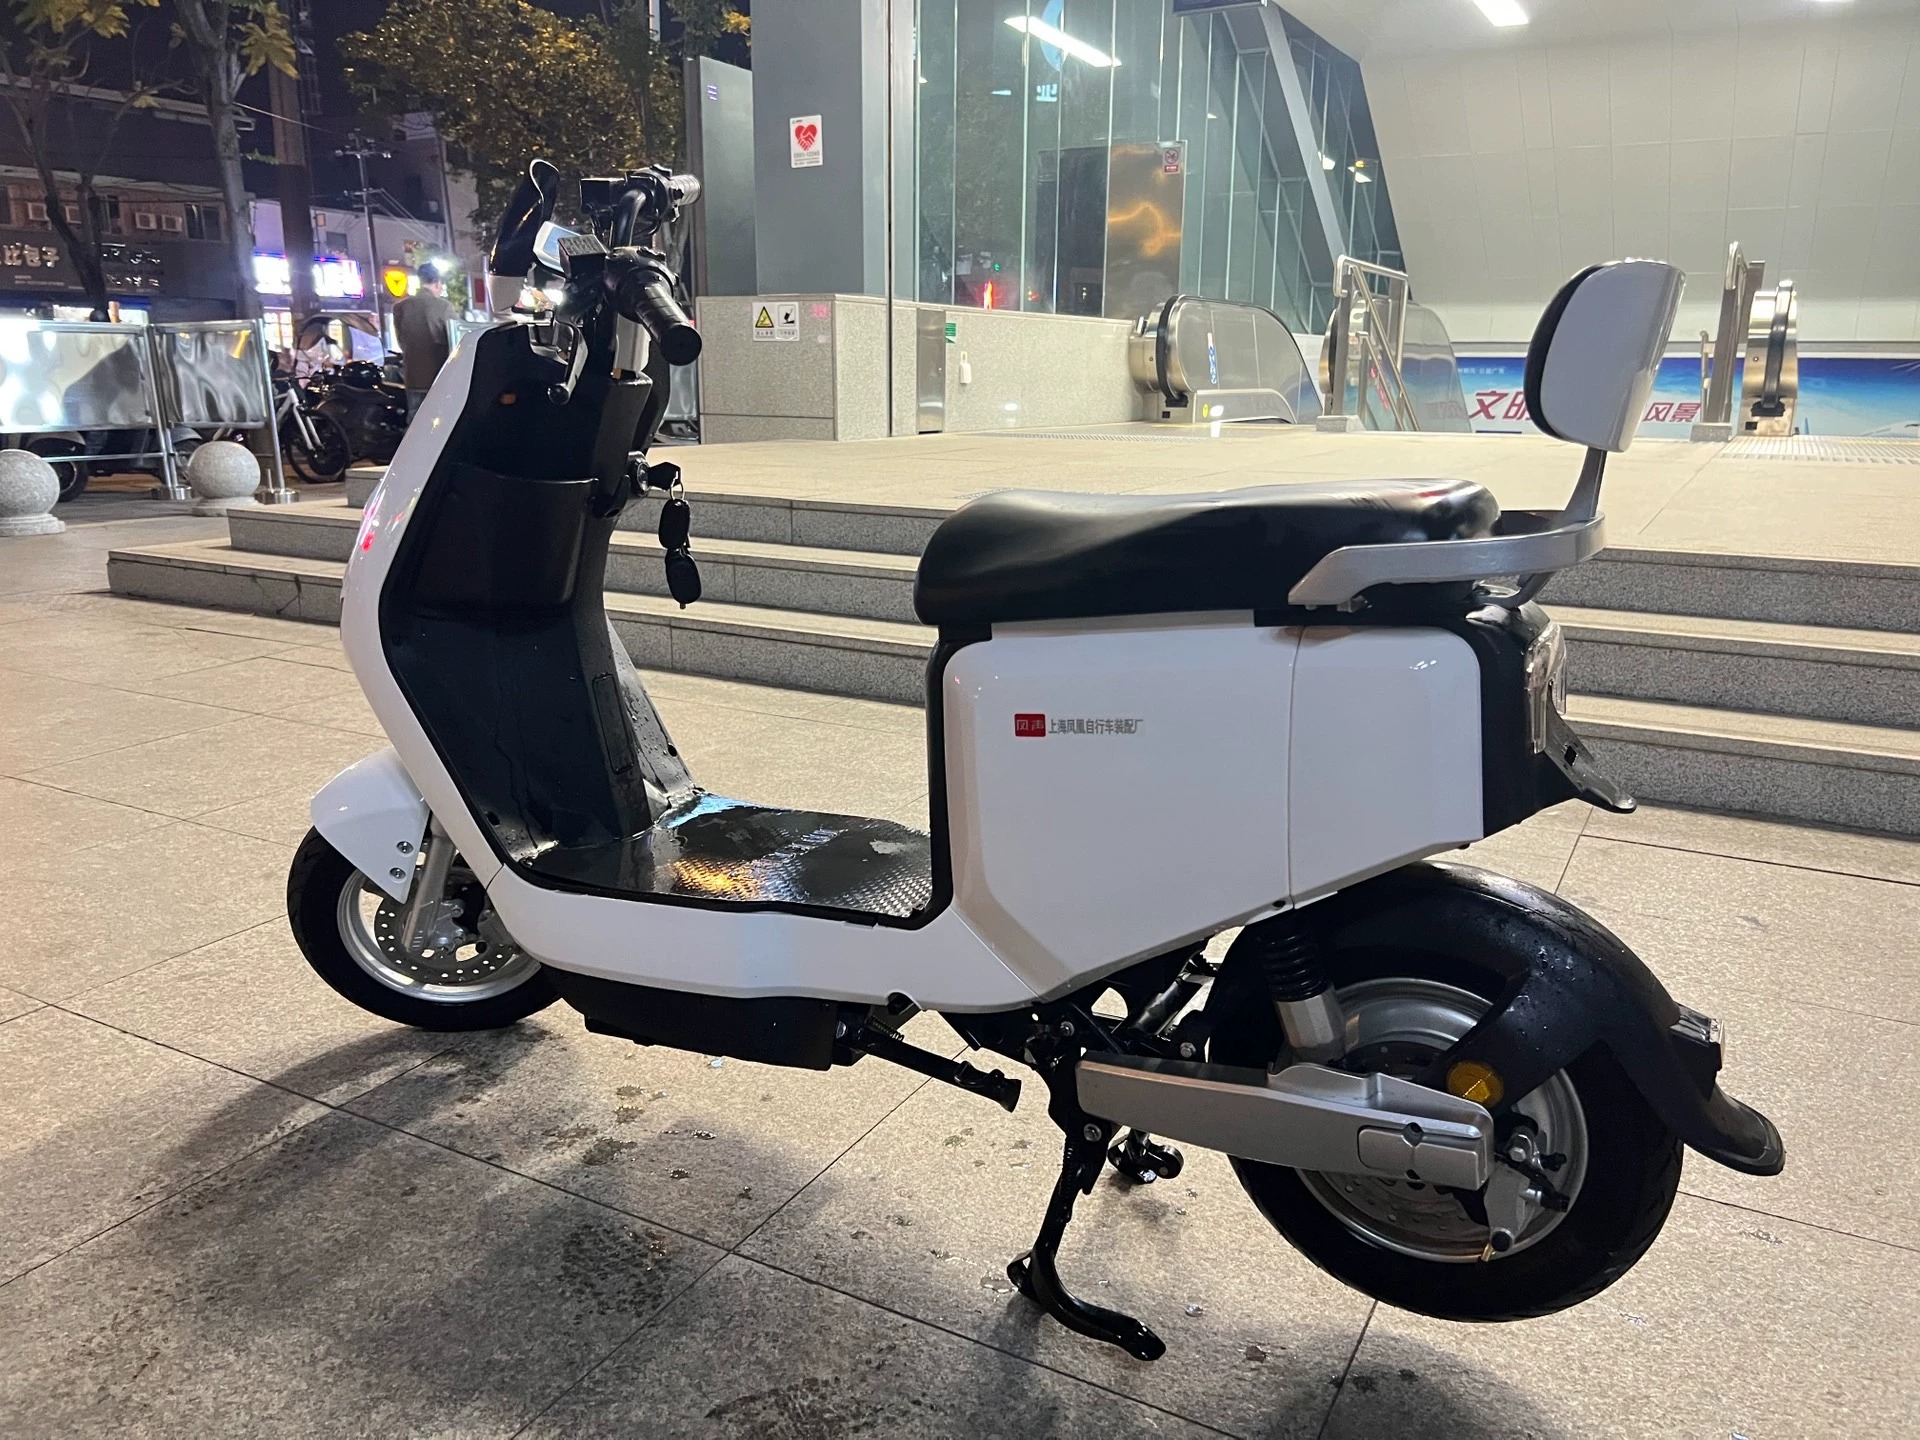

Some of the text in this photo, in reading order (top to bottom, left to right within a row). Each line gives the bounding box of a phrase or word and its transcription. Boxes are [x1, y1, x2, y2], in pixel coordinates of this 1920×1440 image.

[0, 242, 60, 268] 比包子
[1642, 402, 1702, 423] 风景
[1048, 718, 1144, 735] 上海凤凰自行车装配厂
